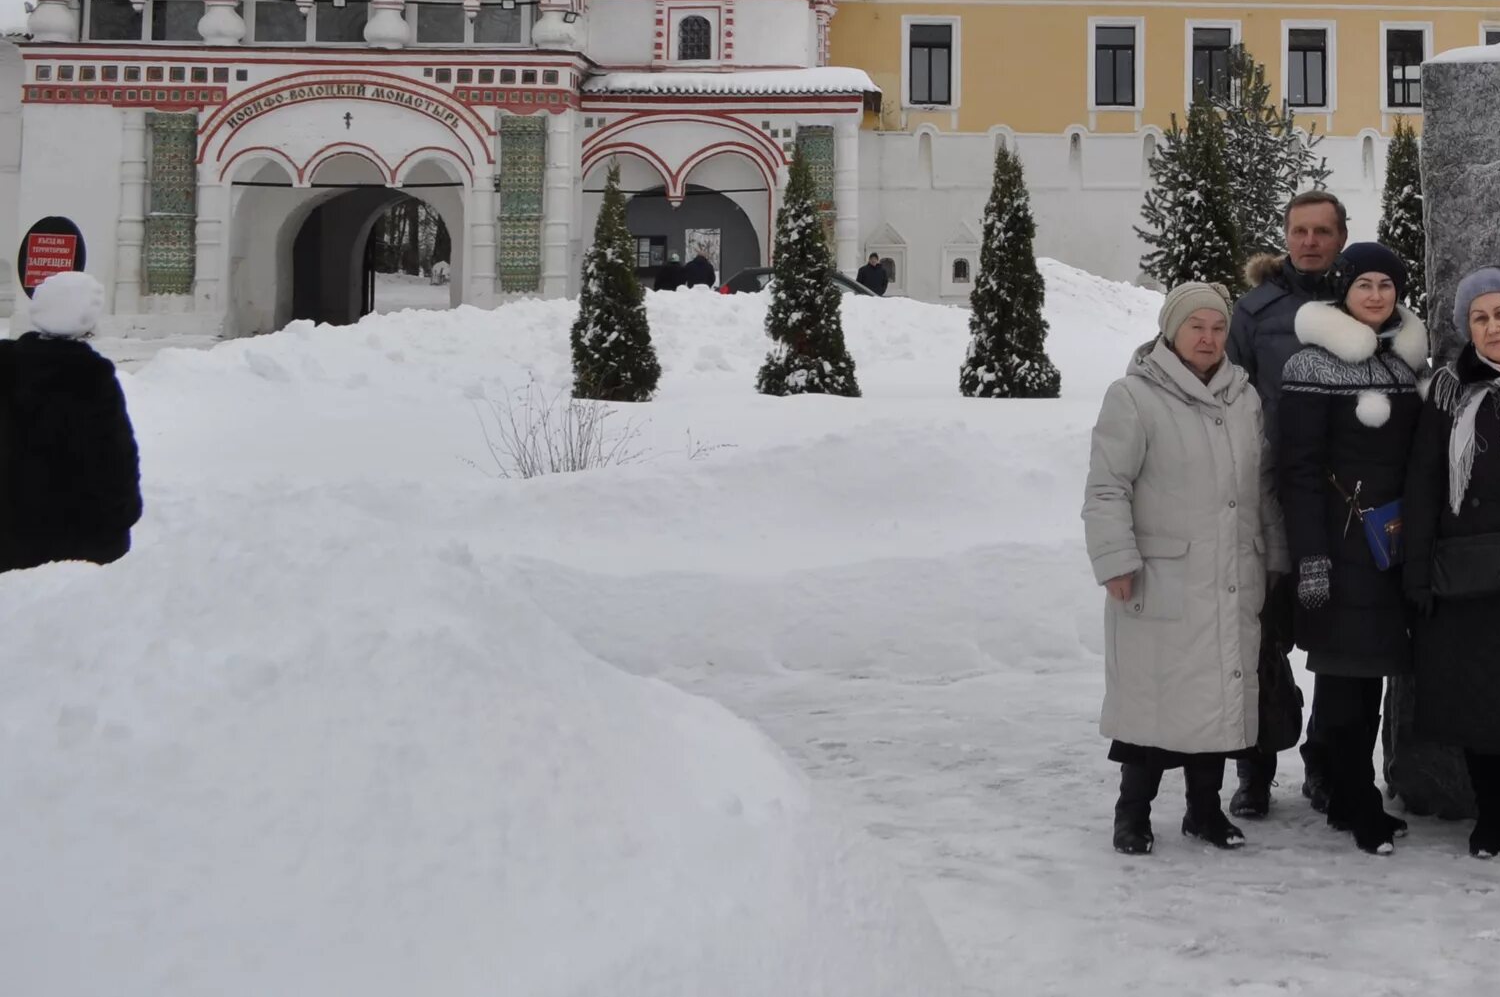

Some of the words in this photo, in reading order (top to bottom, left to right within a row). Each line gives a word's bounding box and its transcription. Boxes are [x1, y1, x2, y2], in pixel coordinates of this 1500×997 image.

[227, 84, 366, 129] ИОСИФО-ВОЛОЦКИЙ
[371, 87, 459, 129] МОНАСТЫРЬ
[28, 257, 72, 268] ЗАПРЕЩЕН
